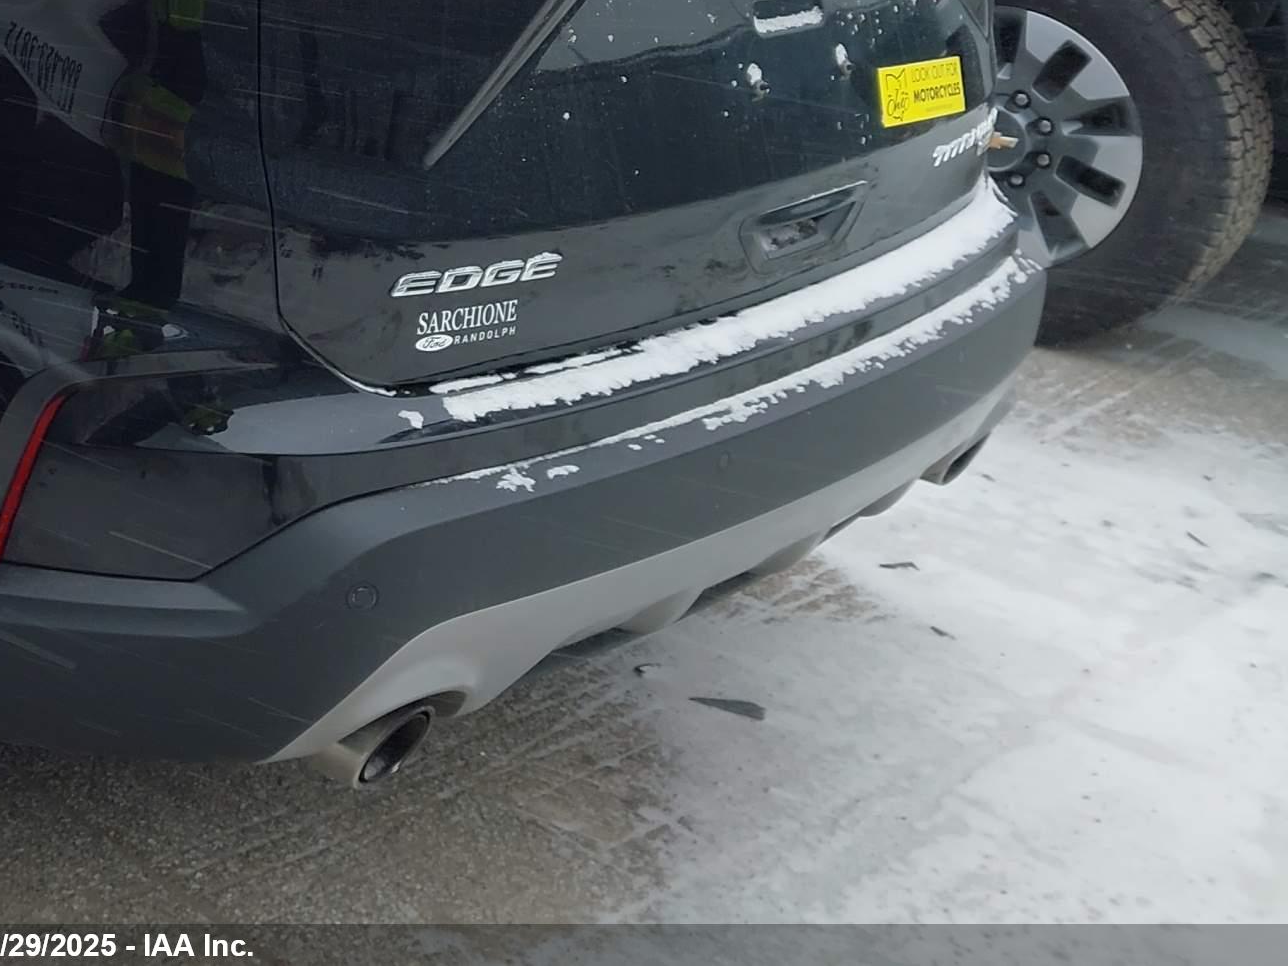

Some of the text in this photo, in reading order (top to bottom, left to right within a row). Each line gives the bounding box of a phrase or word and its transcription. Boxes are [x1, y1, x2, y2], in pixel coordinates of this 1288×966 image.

[912, 67, 929, 83] LOOK
[932, 64, 944, 80] OUT
[913, 82, 961, 103] MOTORCYCLES
[391, 252, 563, 297] EDGE
[417, 299, 518, 335] SARCHIONE
[453, 326, 516, 345] RANDOLPH
